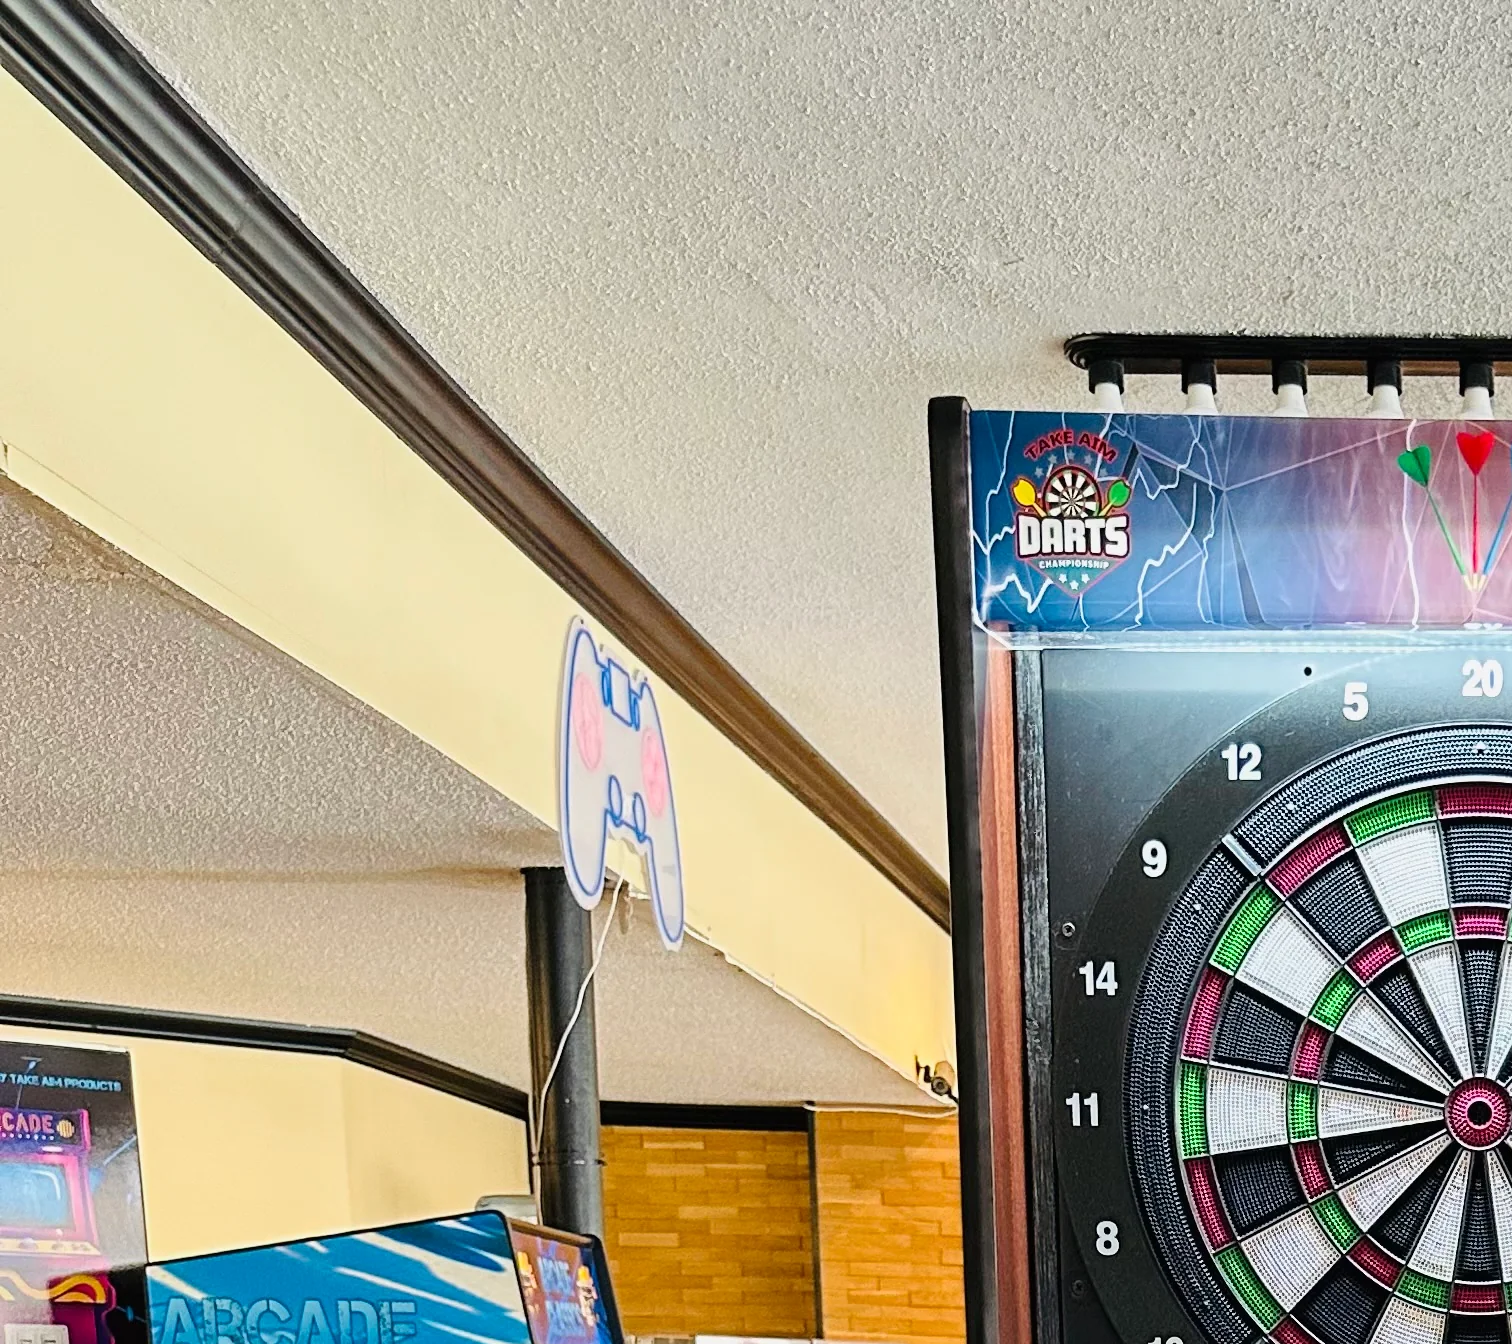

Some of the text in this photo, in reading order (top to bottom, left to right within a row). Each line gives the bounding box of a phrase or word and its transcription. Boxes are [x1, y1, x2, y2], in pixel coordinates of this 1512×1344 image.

[1024, 431, 1118, 462] TAKE AIM
[1018, 514, 1129, 557] DARTS
[1038, 559, 1110, 570] CHAMPIONSHIP
[1461, 659, 1504, 698] 20
[1343, 681, 1370, 721] 5
[1221, 742, 1262, 781] 12
[1141, 839, 1167, 878] 9
[1078, 960, 1118, 996] 14
[0, 1111, 55, 1134] CADE
[1065, 1092, 1099, 1127] 11
[1095, 1220, 1120, 1256] 8
